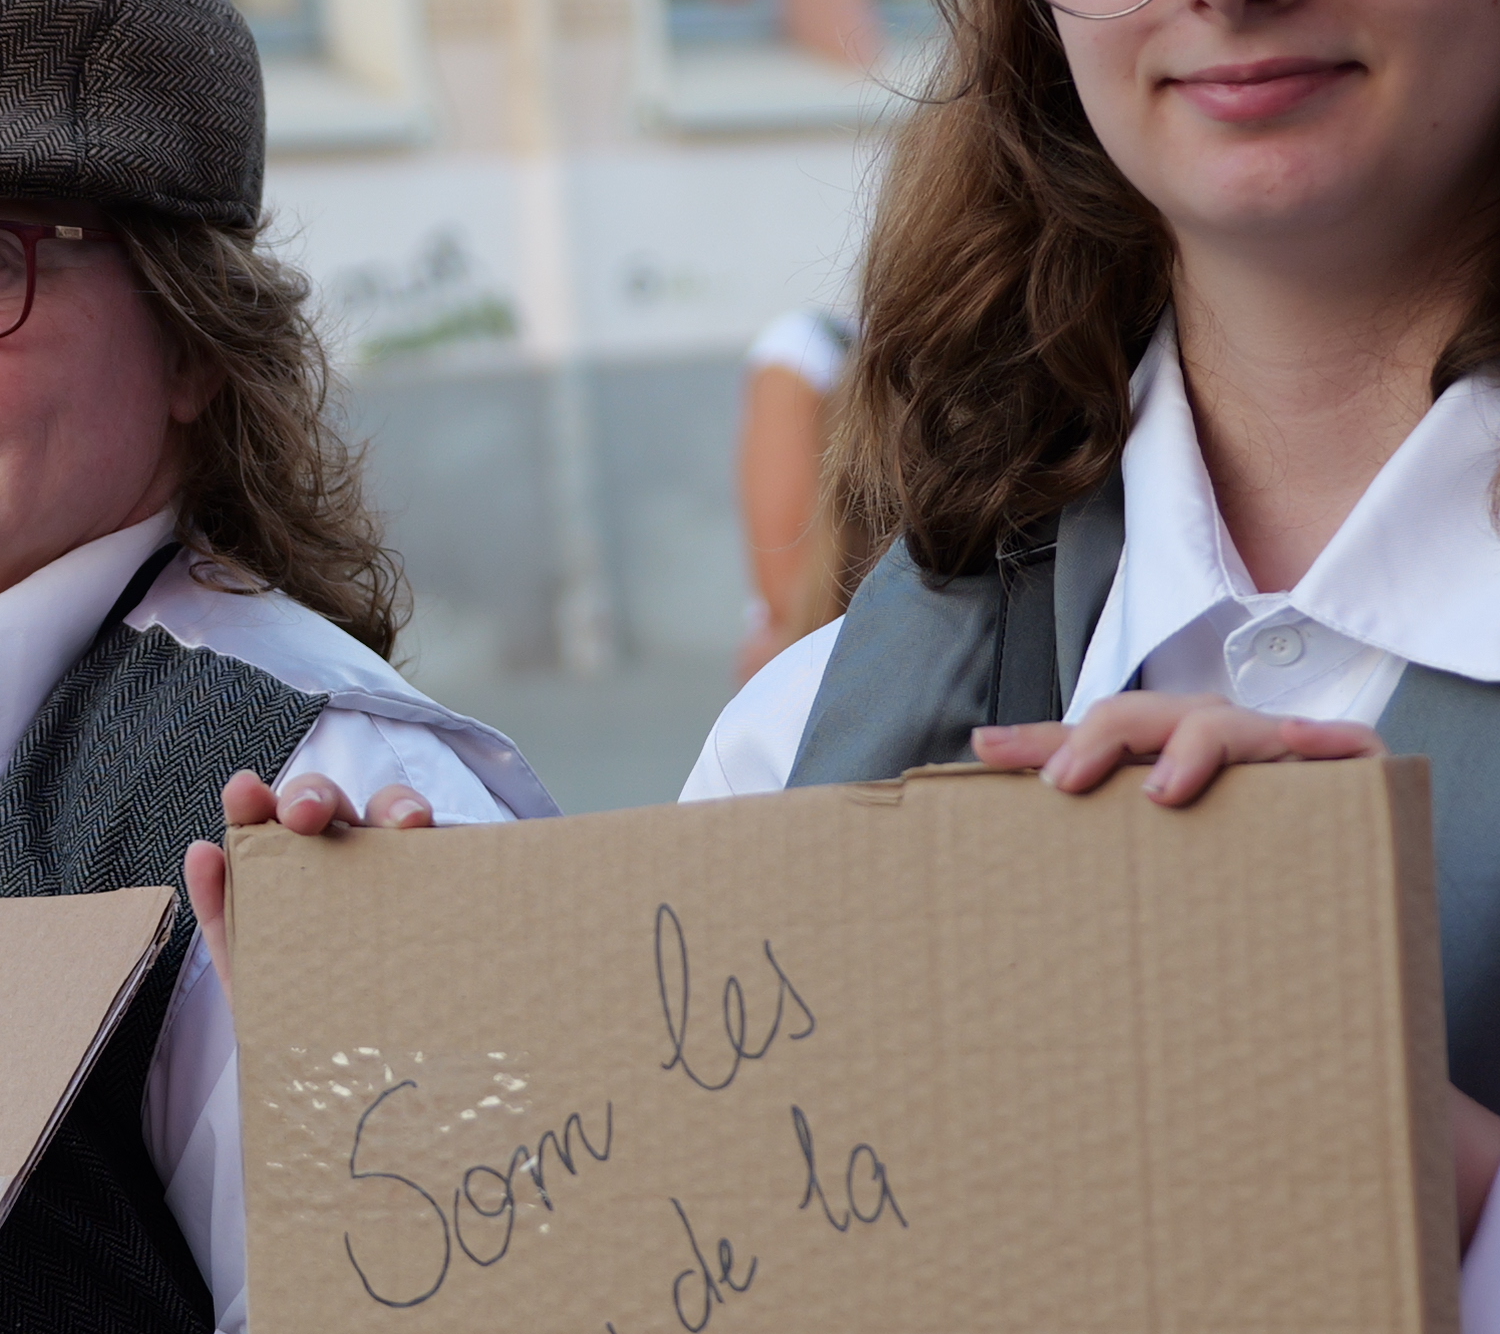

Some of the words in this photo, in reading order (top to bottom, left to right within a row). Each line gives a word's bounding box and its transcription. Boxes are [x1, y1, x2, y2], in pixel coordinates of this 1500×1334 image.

[344, 1081, 613, 1308] Som
[654, 902, 815, 1091] les
[671, 1197, 759, 1333] de
[791, 1105, 908, 1231] la
